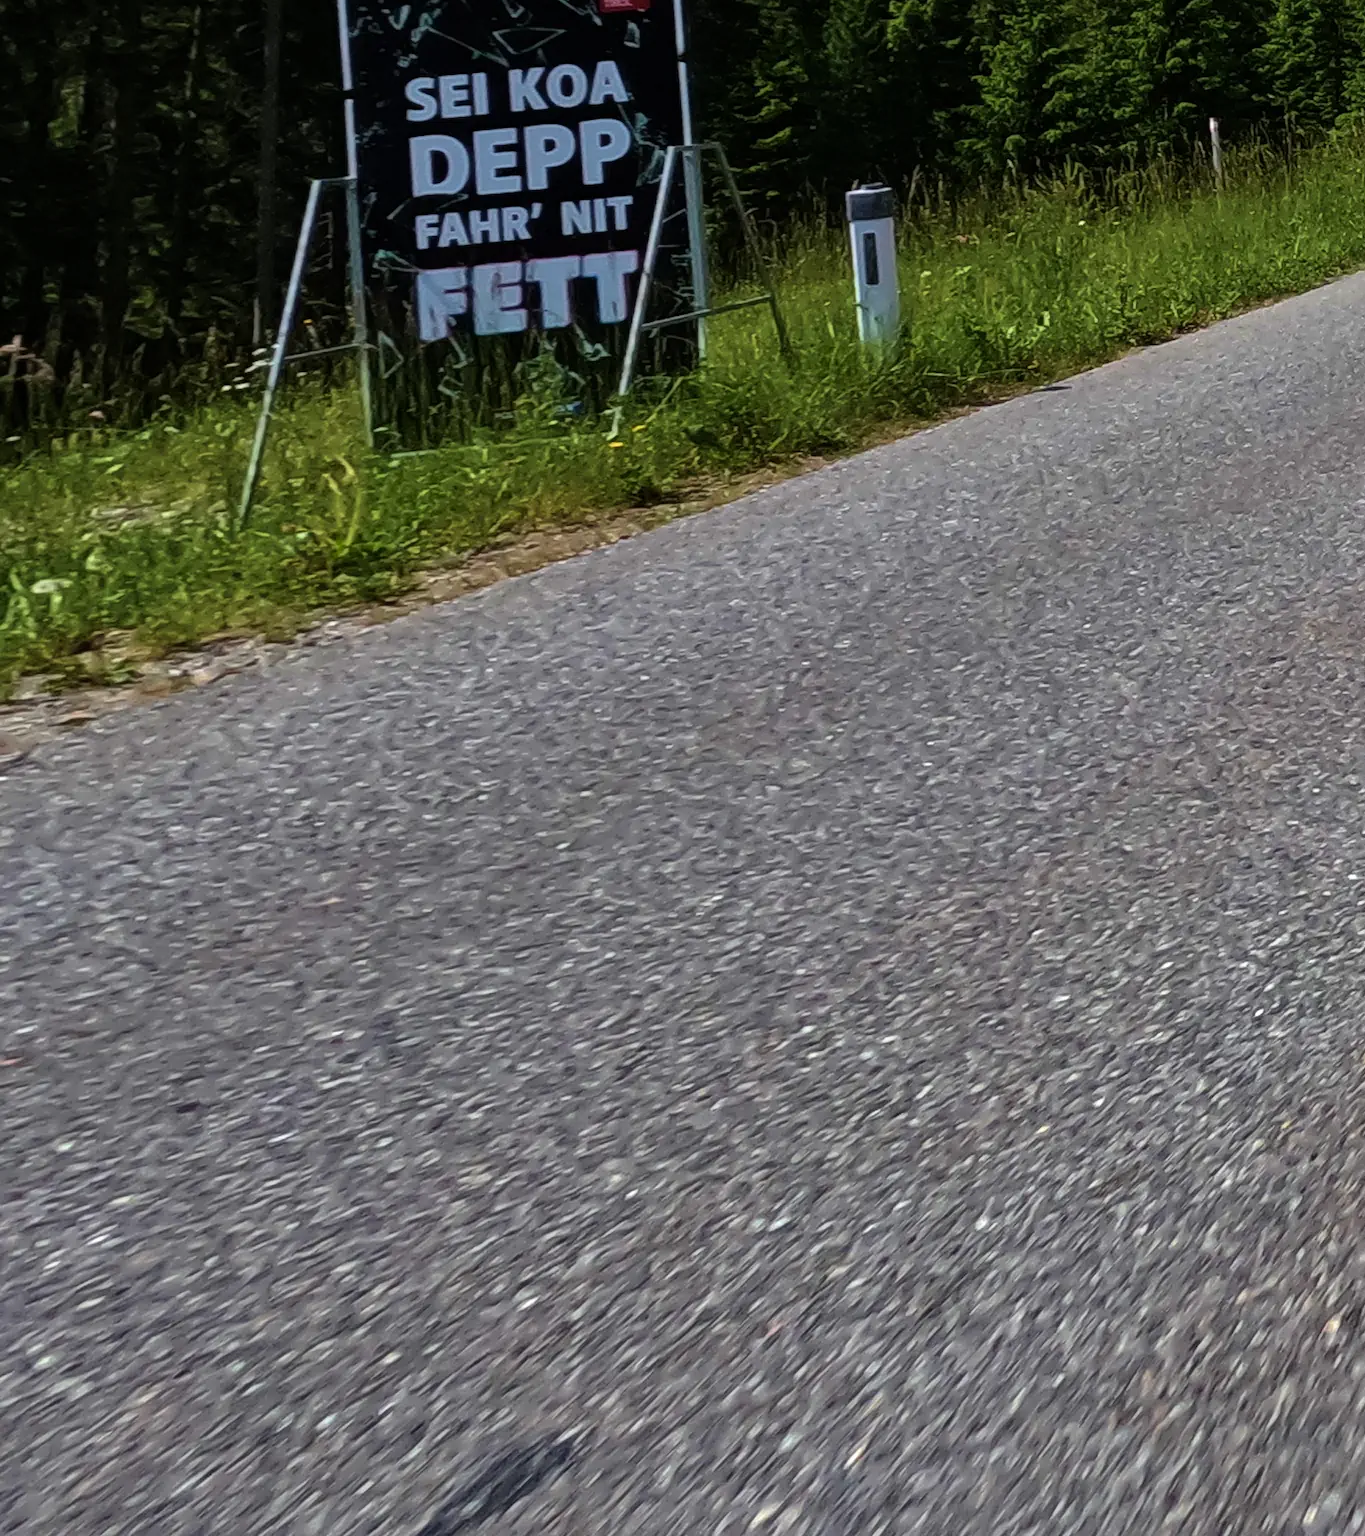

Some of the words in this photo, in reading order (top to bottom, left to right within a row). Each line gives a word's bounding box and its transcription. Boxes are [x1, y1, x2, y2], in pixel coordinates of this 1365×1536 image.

[405, 73, 489, 121] SEI
[509, 61, 627, 113] KOA
[409, 119, 632, 197] DEPP
[560, 197, 633, 236] NIT
[415, 251, 638, 341] FETT
